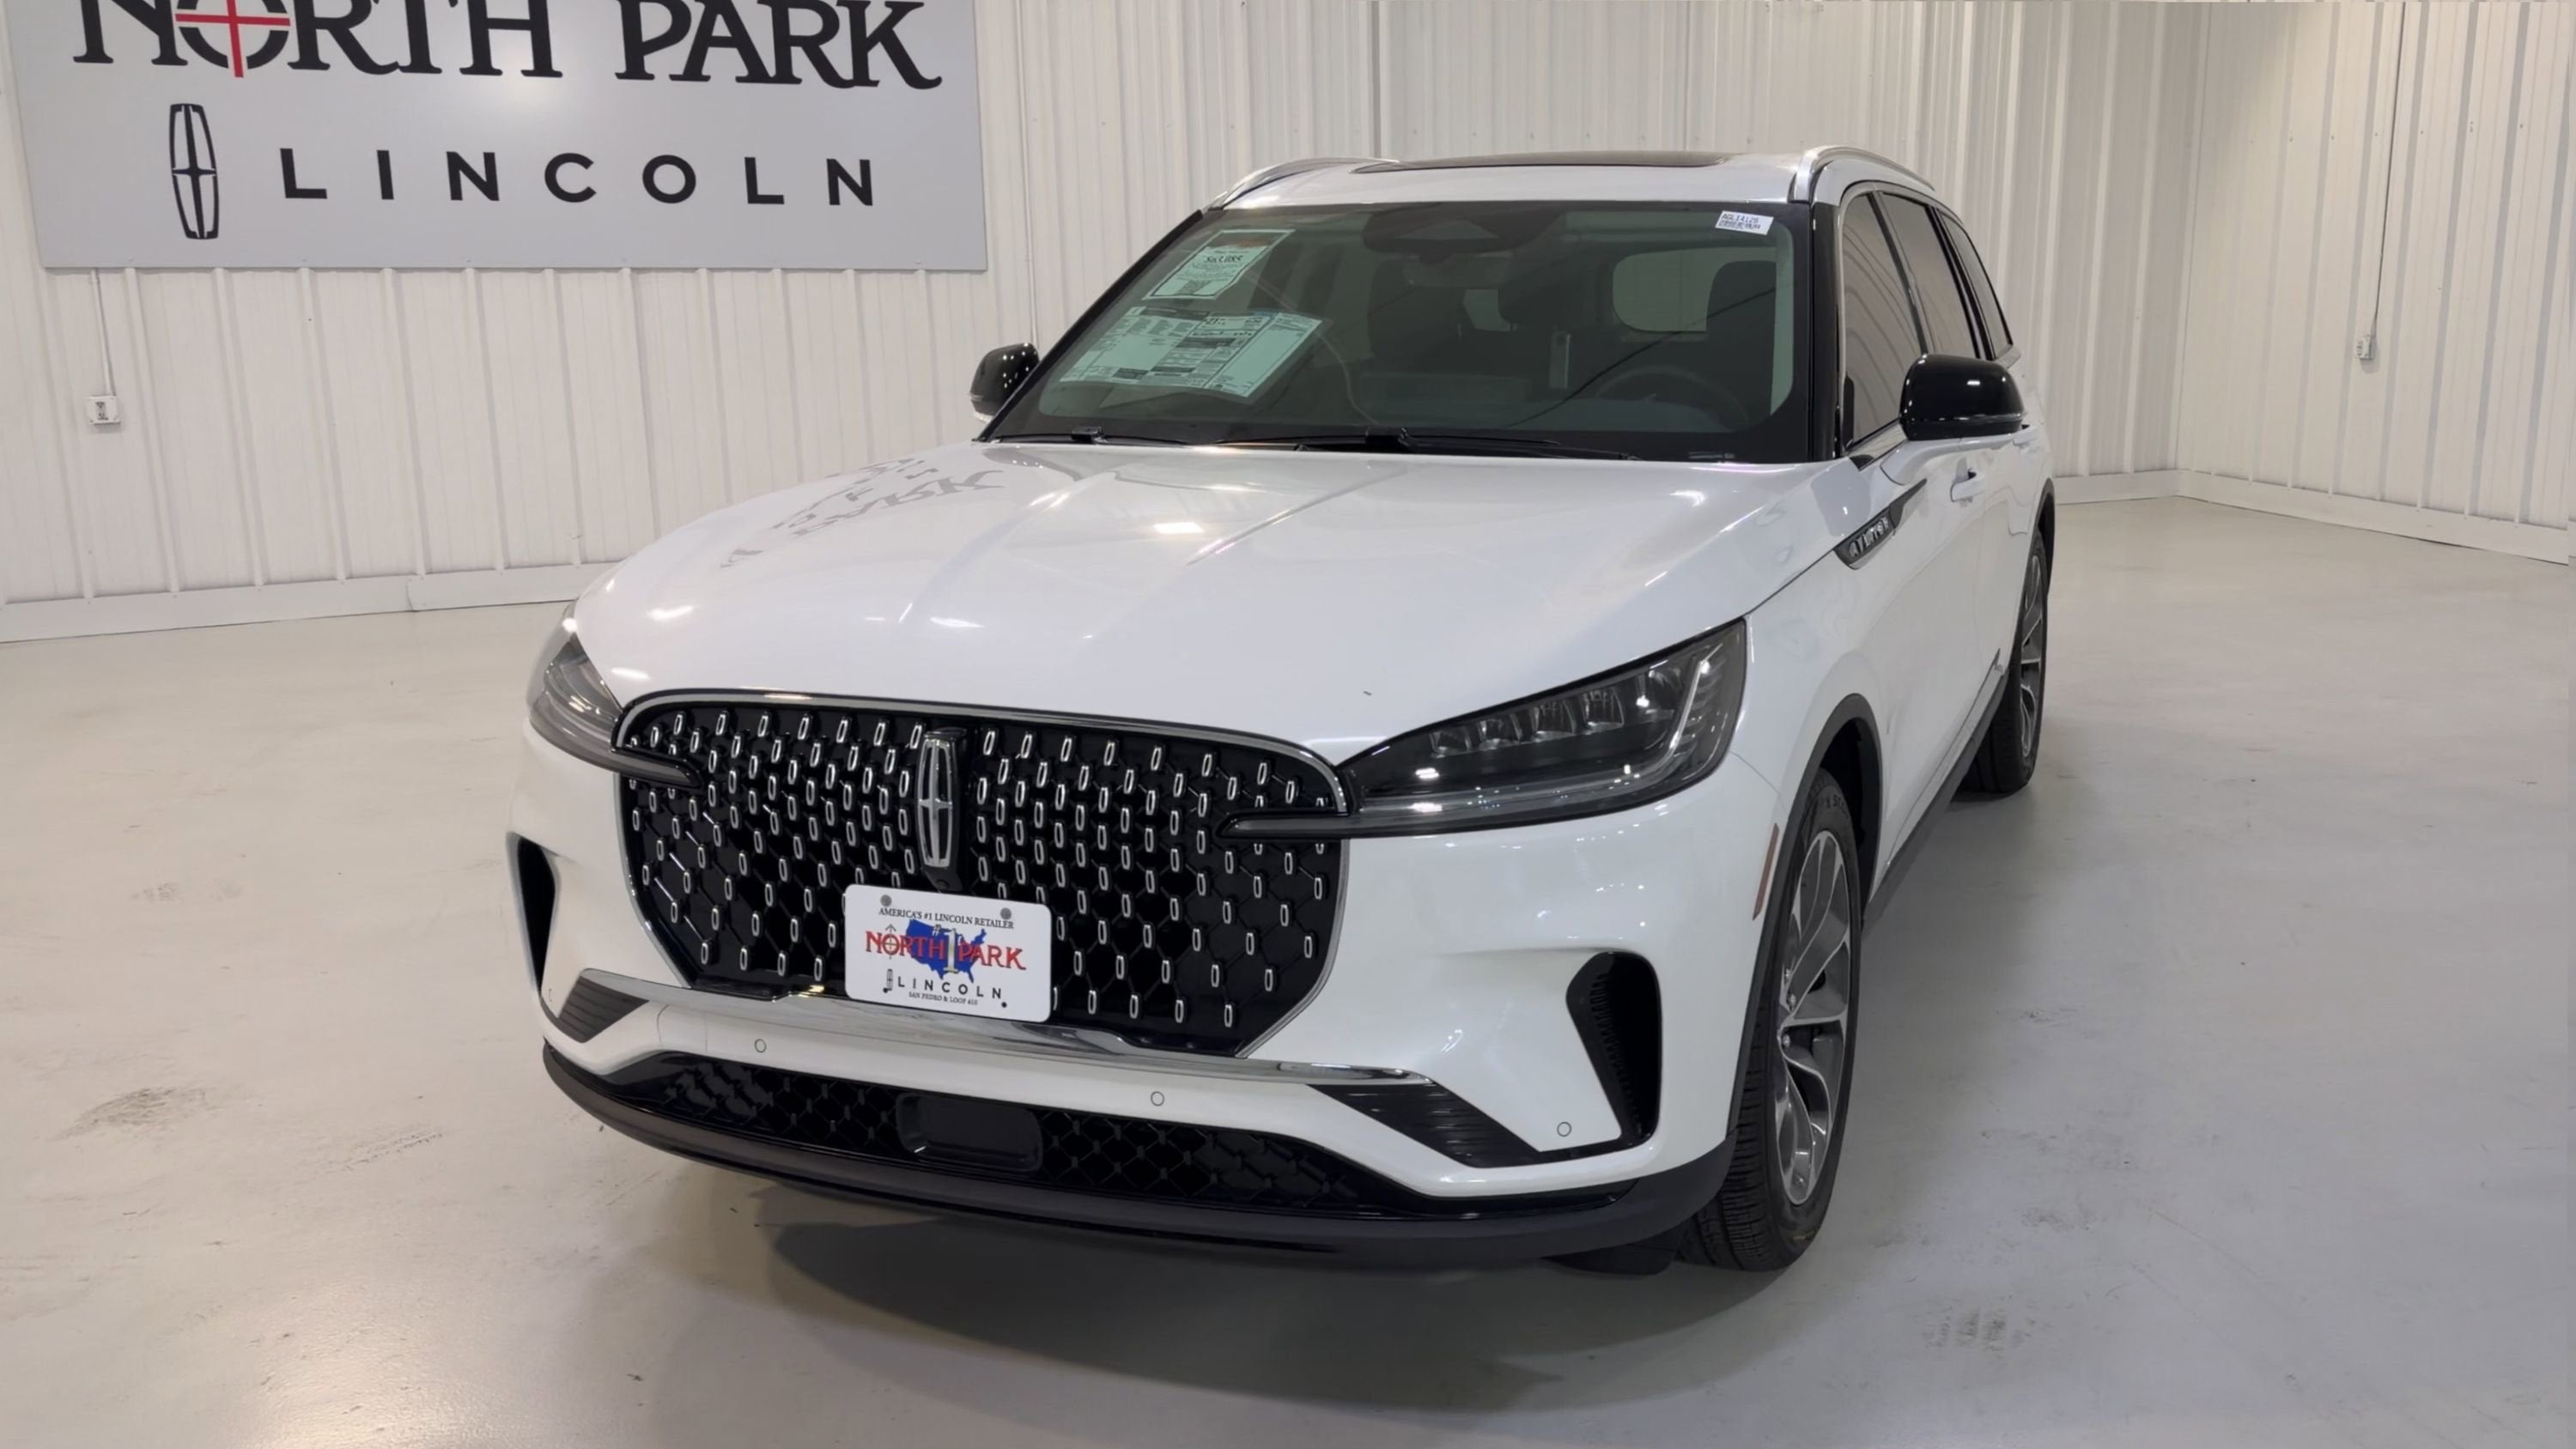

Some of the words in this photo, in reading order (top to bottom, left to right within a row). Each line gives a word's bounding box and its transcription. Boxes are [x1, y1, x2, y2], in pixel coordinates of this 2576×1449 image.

[73, 0, 563, 78] NORTH
[615, 0, 943, 90] PARK
[279, 147, 873, 207] LINCOLN
[879, 907, 922, 919] AMERICA'S
[924, 912, 933, 921] #1
[934, 912, 973, 925] LINCOLN
[974, 918, 1014, 929] RETAILER
[866, 931, 945, 961] NORTH
[957, 938, 1027, 971] PARK
[897, 975, 1002, 999] LINCOLN
[908, 991, 920, 999] SAN
[921, 992, 943, 1002] PEDRO
